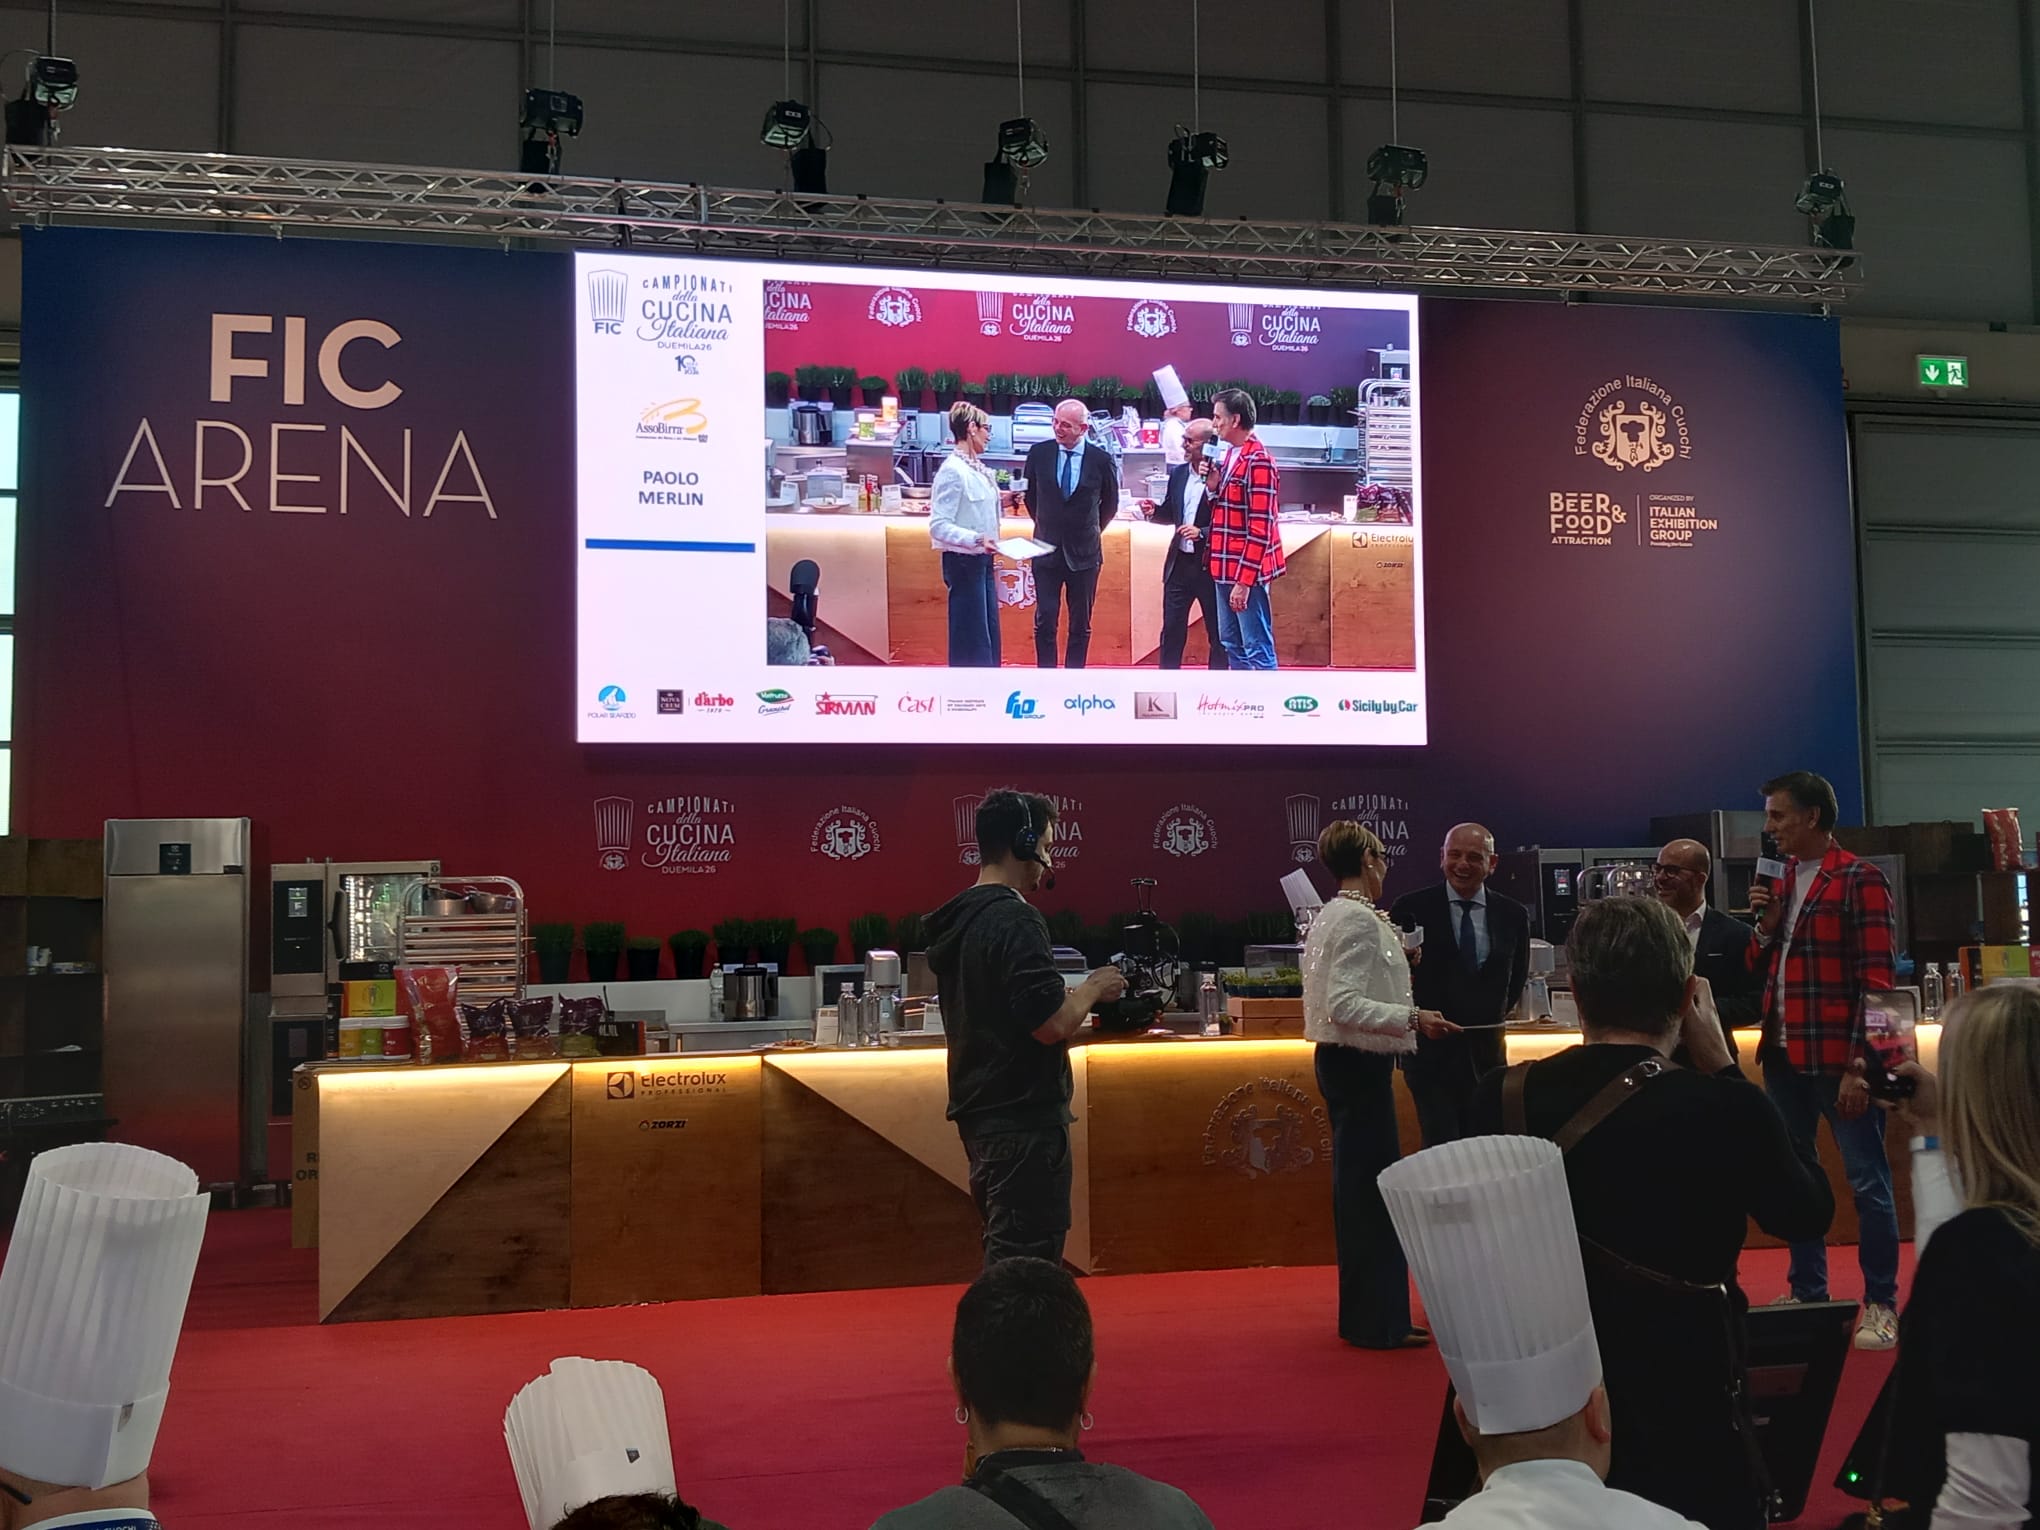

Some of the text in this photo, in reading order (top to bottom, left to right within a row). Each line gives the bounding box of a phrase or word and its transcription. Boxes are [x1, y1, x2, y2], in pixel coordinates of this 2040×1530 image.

[642, 274, 732, 293] CAMPIONATI
[763, 292, 812, 309] CINA
[642, 300, 732, 323] CUCINA
[1012, 303, 1075, 322] CUCINA
[594, 322, 622, 335] FIC
[636, 317, 729, 341] Italiana
[1009, 317, 1073, 336] Italiana
[1262, 314, 1321, 332] CUCINA
[1258, 328, 1320, 346] Italiana
[657, 341, 712, 351] DUEMILA26
[210, 313, 404, 410] FIC
[1574, 374, 1692, 460] Federazione Italiana Cuochi
[636, 422, 684, 435] AssoBirra
[104, 417, 498, 520] ARENA
[643, 470, 699, 486] PAOLO
[638, 490, 704, 506] MERLIN
[1550, 492, 1610, 514] BEER
[1550, 504, 1627, 535] FOOD &
[1649, 506, 1695, 518] ITALIAN
[1650, 518, 1718, 530] EXHIBITION
[1371, 533, 1414, 543] Electrolu
[1551, 536, 1612, 545] ATTRACTION
[1650, 529, 1693, 541] GROUP
[816, 702, 876, 716] SIRMAN
[1064, 694, 1116, 716] alpha
[1147, 696, 1164, 712] K
[1352, 699, 1418, 714] Sicily by Car
[648, 796, 735, 814] CAMPIONATI
[1332, 794, 1408, 810] CAMPIONATI
[676, 811, 703, 824] della
[647, 824, 735, 845] CUCINA
[641, 841, 731, 867] Italiana
[641, 1072, 726, 1088] Electrolux
[640, 1088, 726, 1096] PROFESSIONAL
[651, 1120, 688, 1129] ZORZI
